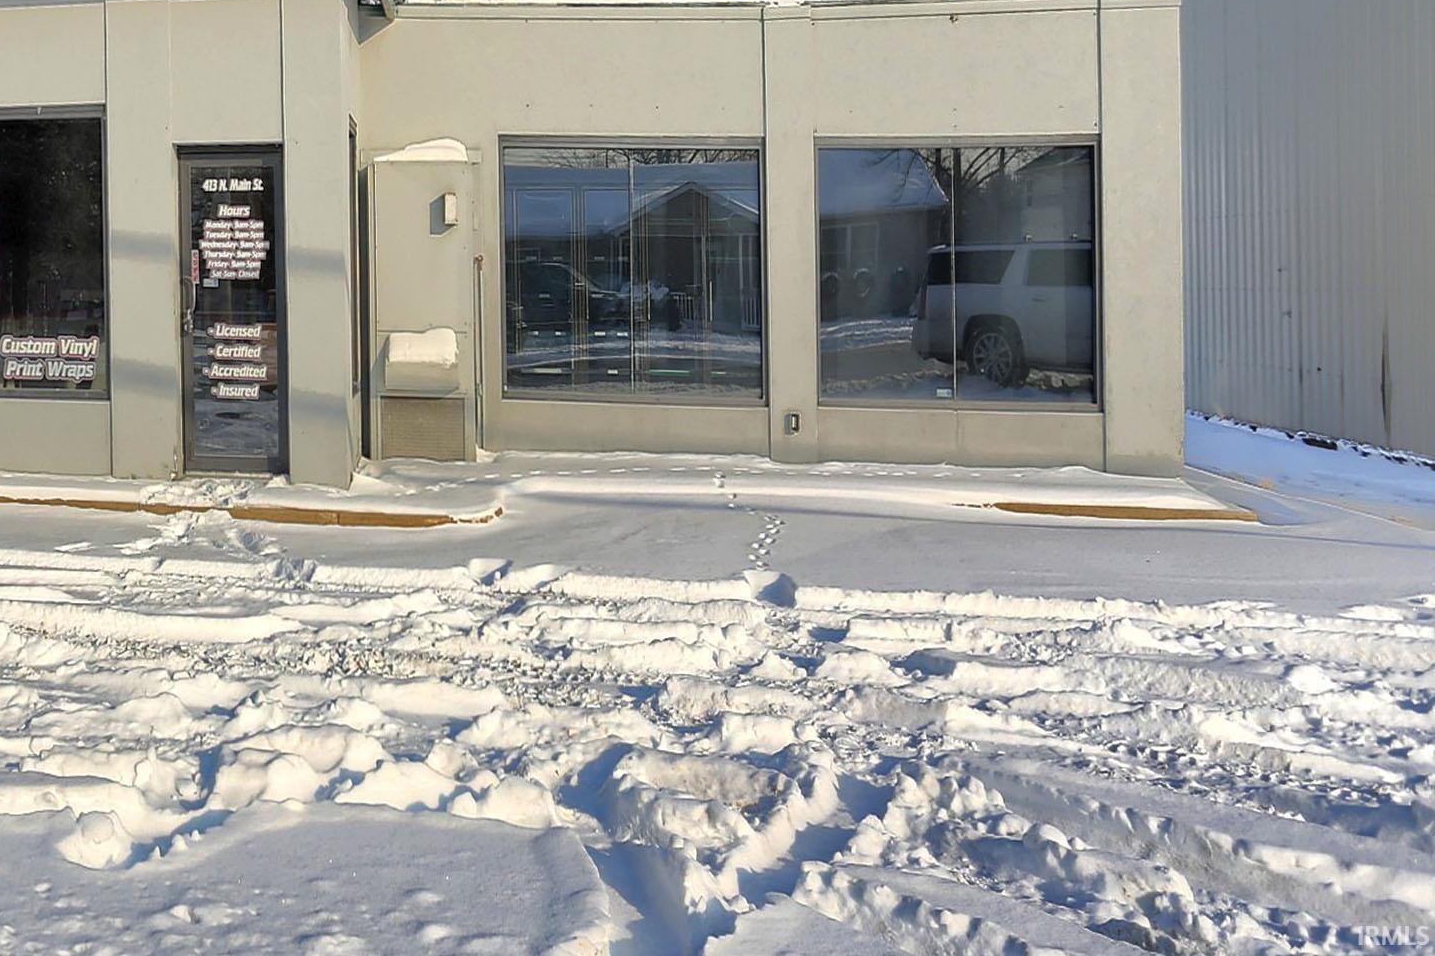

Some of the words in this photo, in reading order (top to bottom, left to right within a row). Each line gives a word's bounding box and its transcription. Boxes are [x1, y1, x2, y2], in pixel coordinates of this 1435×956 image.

[202, 178, 217, 192] 413
[229, 178, 252, 191] Main
[218, 204, 251, 217] Hours
[215, 324, 262, 337] Licensed
[1, 338, 56, 354] Custom
[60, 338, 98, 357] Vinyl
[216, 344, 262, 358] Certified
[6, 360, 43, 376] Print
[47, 361, 94, 380] Wraps
[211, 365, 267, 378] Accredited
[218, 384, 259, 397] Insured
